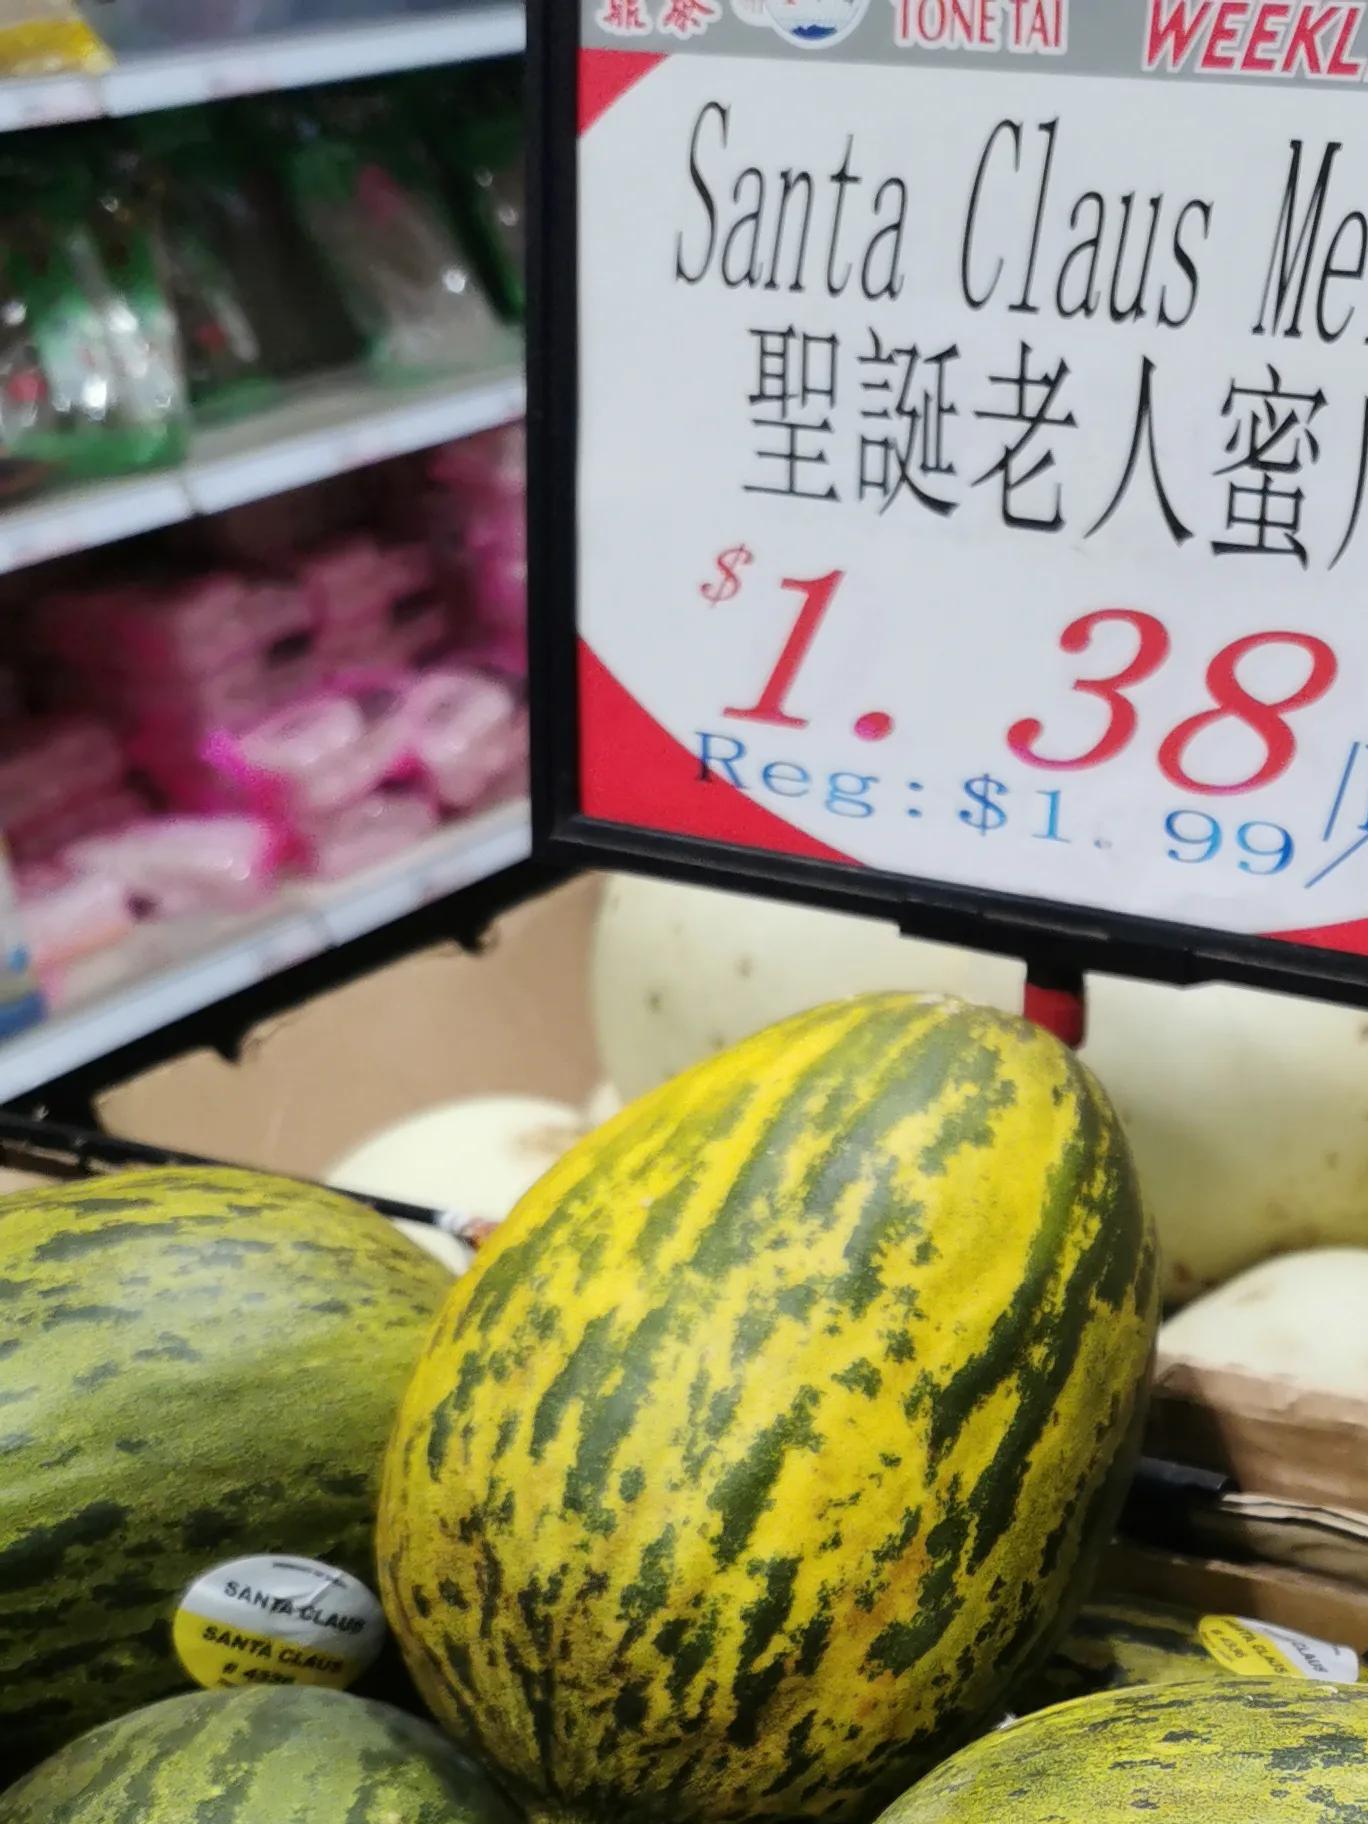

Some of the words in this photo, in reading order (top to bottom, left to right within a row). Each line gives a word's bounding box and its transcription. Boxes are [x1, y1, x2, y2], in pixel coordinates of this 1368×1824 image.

[675, 100, 909, 302] Santa
[961, 115, 1213, 328] Claus
[224, 1579, 293, 1615] SANTA
[202, 1625, 272, 1658] SANTA
